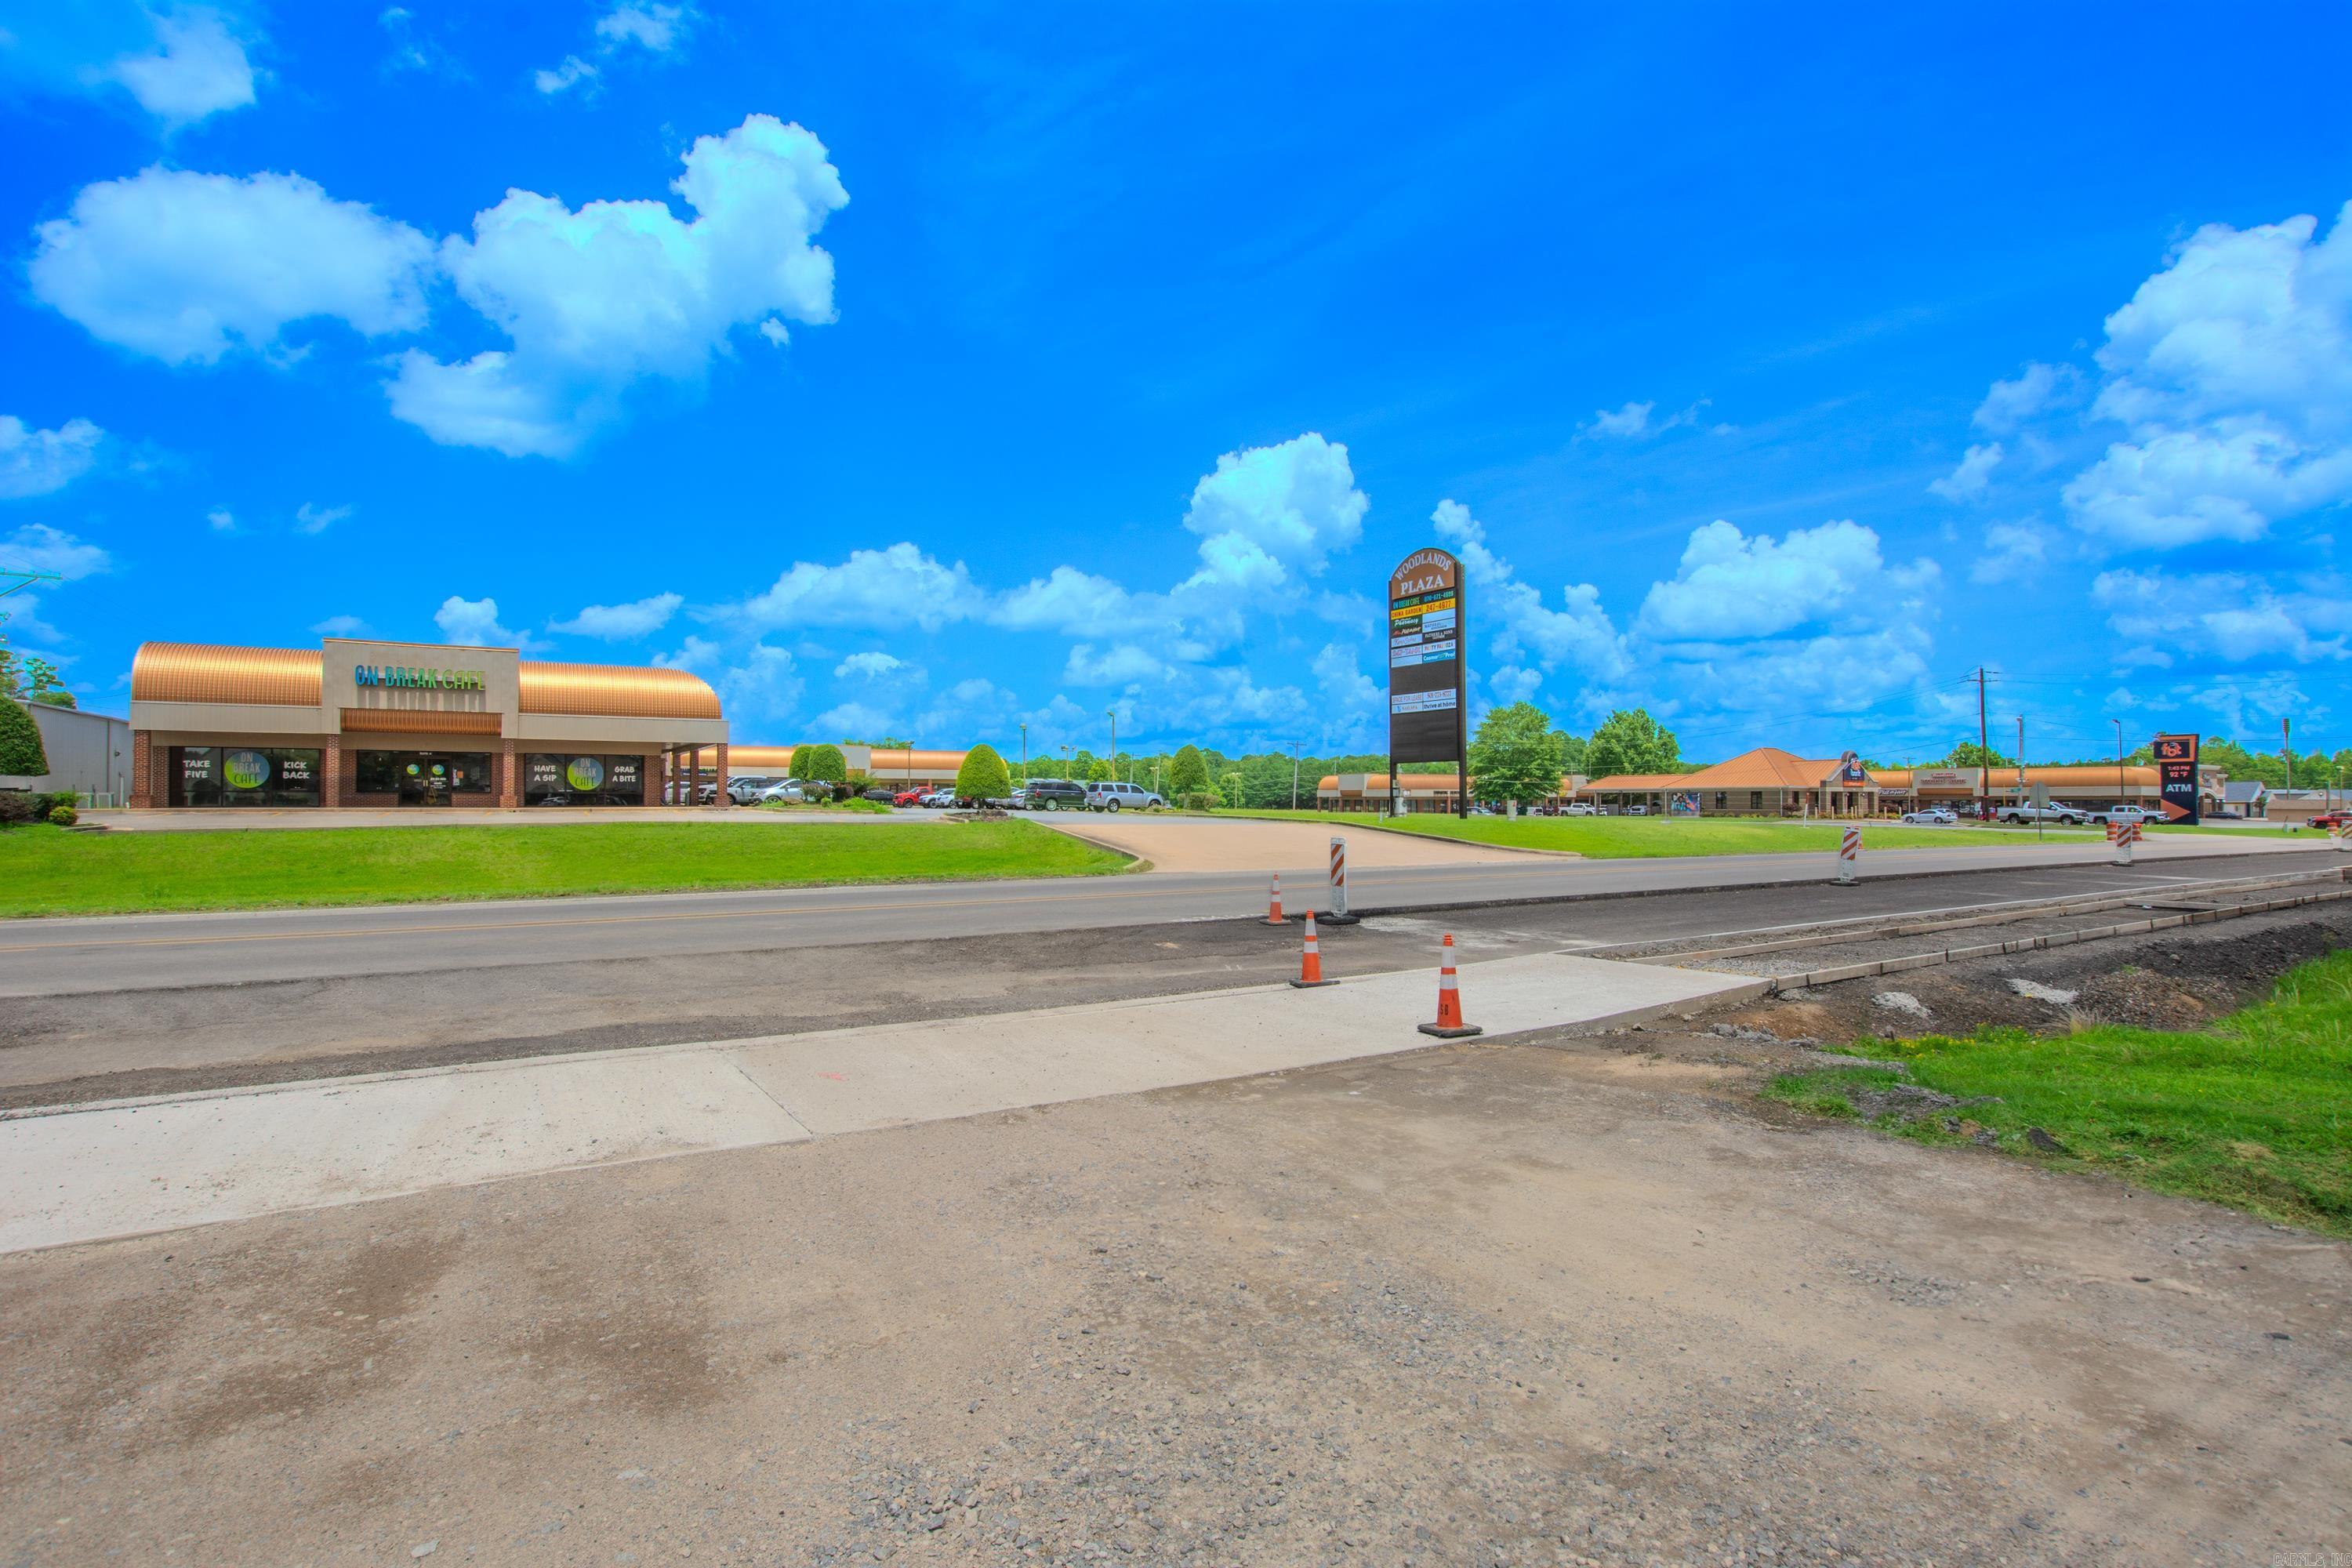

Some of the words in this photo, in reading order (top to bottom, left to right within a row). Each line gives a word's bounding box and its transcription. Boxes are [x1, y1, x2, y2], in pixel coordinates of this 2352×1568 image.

[1395, 552, 1451, 580] WOODLANDS
[1400, 574, 1444, 595] PLAZA
[1394, 618, 1418, 626] Pharmacy
[355, 665, 379, 687] ON
[385, 666, 437, 688] BREAK
[442, 669, 486, 691] CAFE
[241, 752, 253, 763] ON
[183, 760, 211, 768] TAKE
[233, 762, 261, 773] BREAK
[284, 760, 307, 769] KICK
[580, 758, 590, 768] ON
[185, 770, 209, 779] FIVE
[282, 771, 310, 779] BACK
[574, 768, 597, 777] BREAK
